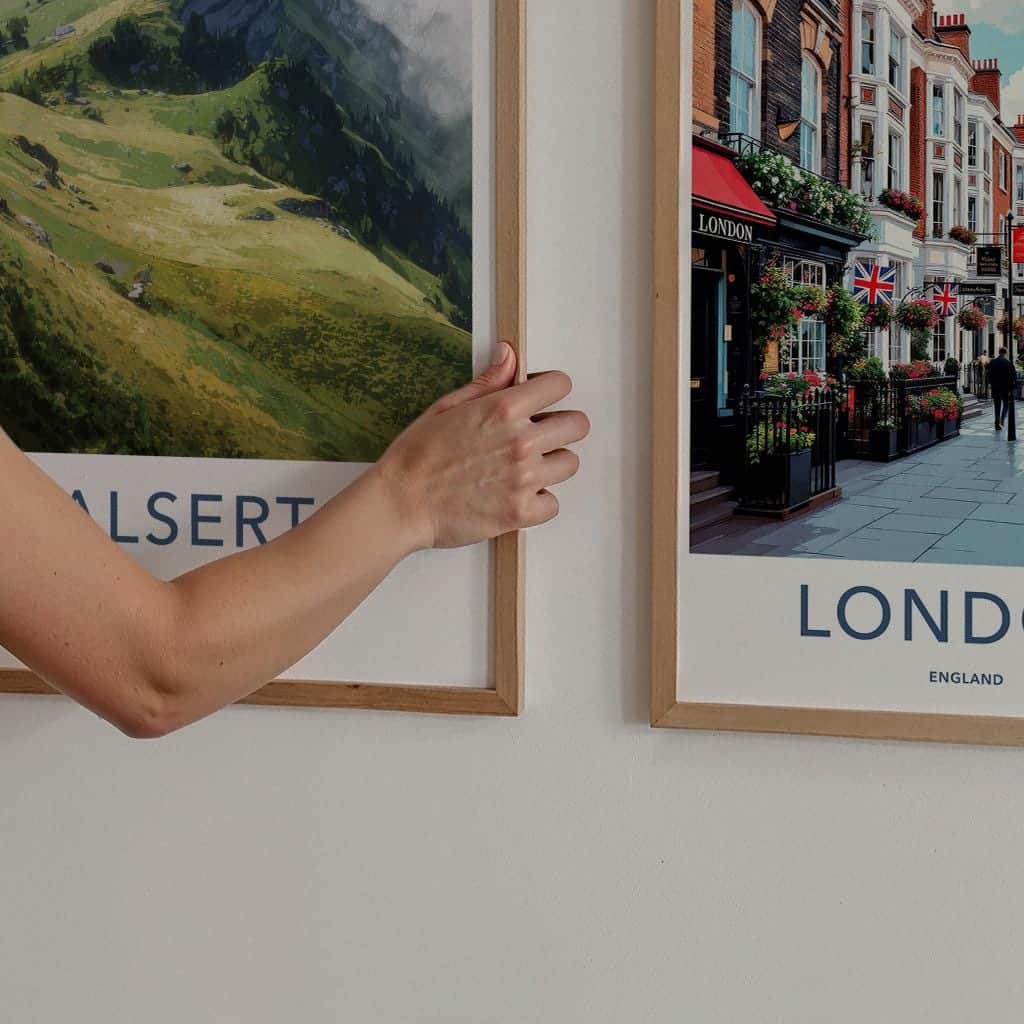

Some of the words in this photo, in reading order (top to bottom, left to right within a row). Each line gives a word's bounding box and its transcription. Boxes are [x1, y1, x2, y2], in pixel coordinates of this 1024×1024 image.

[698, 213, 753, 242] LONDON
[799, 583, 1024, 645] LOND
[928, 670, 1004, 687] ENGLAND
